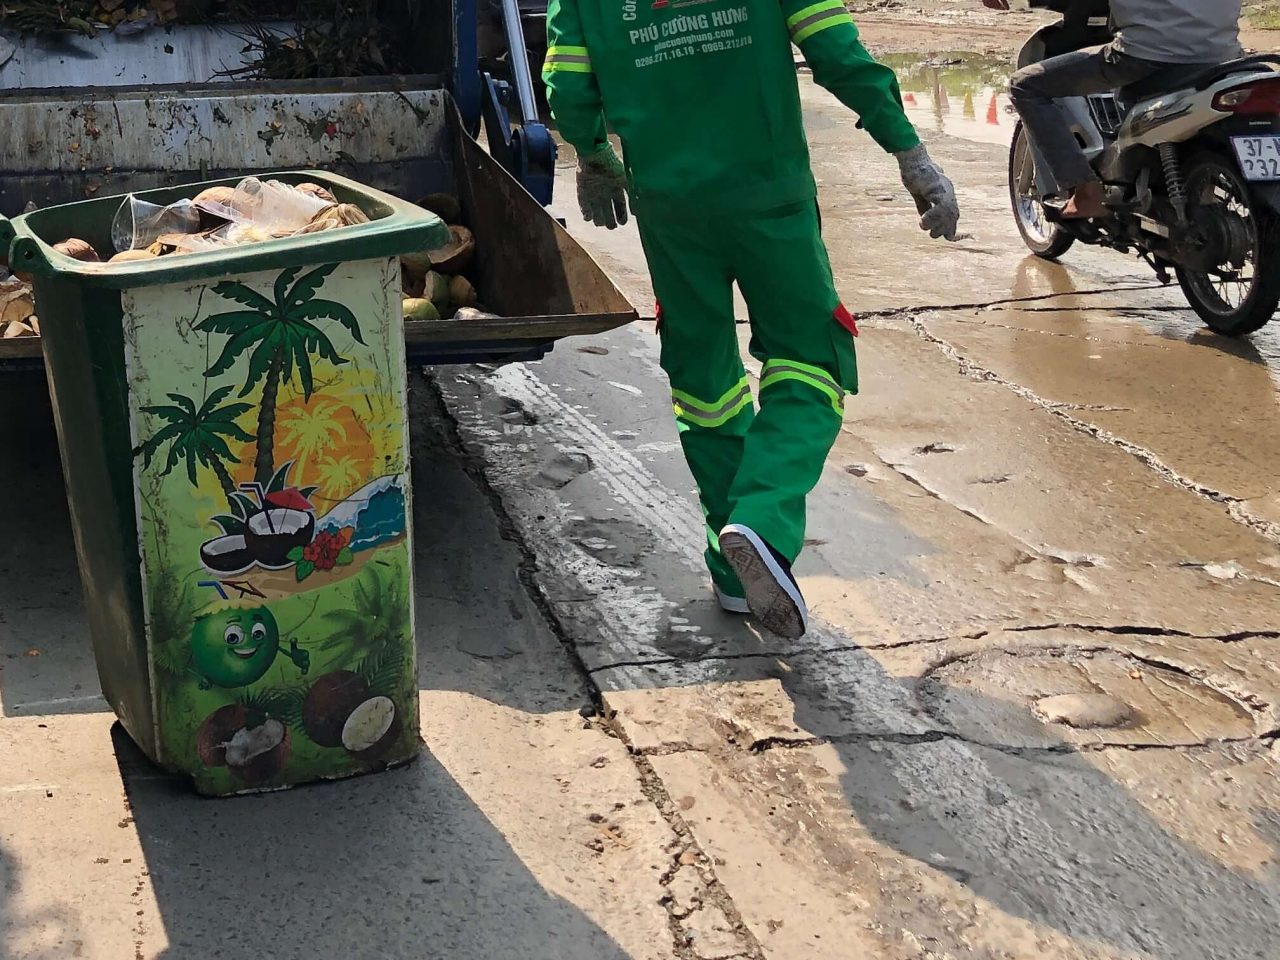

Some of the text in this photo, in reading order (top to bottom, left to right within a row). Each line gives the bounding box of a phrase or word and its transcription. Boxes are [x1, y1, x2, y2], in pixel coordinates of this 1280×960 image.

[628, 6, 749, 45] PHÚ CƯỜNG HƯNG
